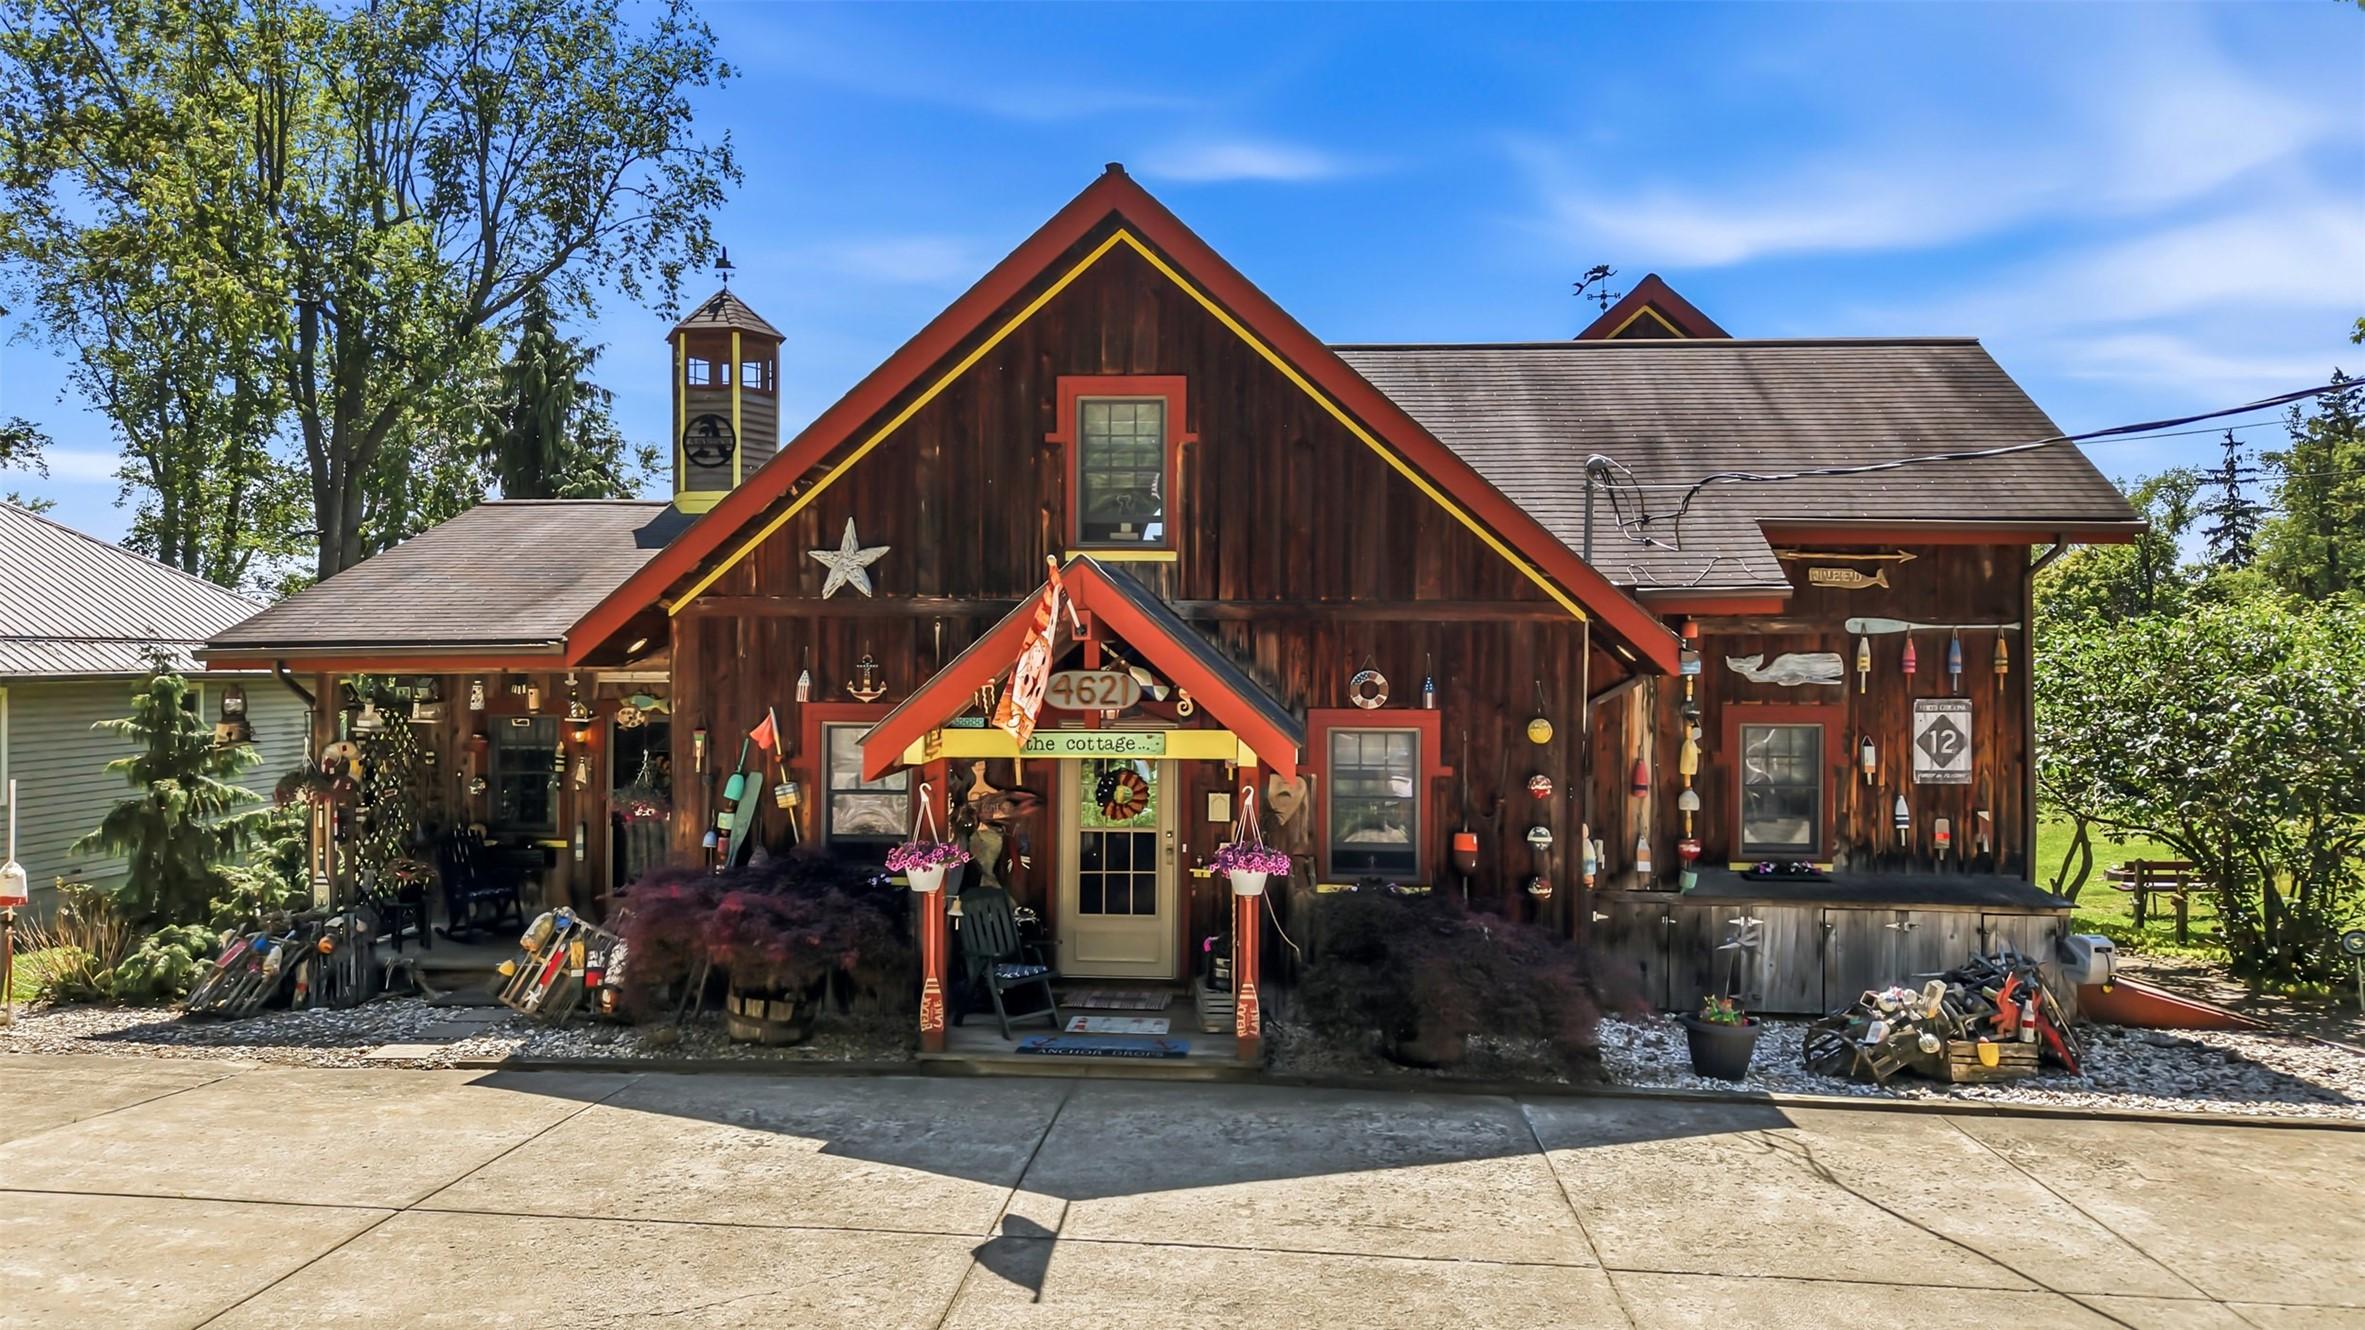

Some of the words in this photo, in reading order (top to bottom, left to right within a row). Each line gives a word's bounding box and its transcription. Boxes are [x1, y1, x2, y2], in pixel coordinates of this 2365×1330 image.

[1052, 674, 1129, 705] 4621
[1026, 736, 1055, 751] the
[1930, 729, 1956, 754] 12
[1039, 1048, 1102, 1056] ANCHOR
